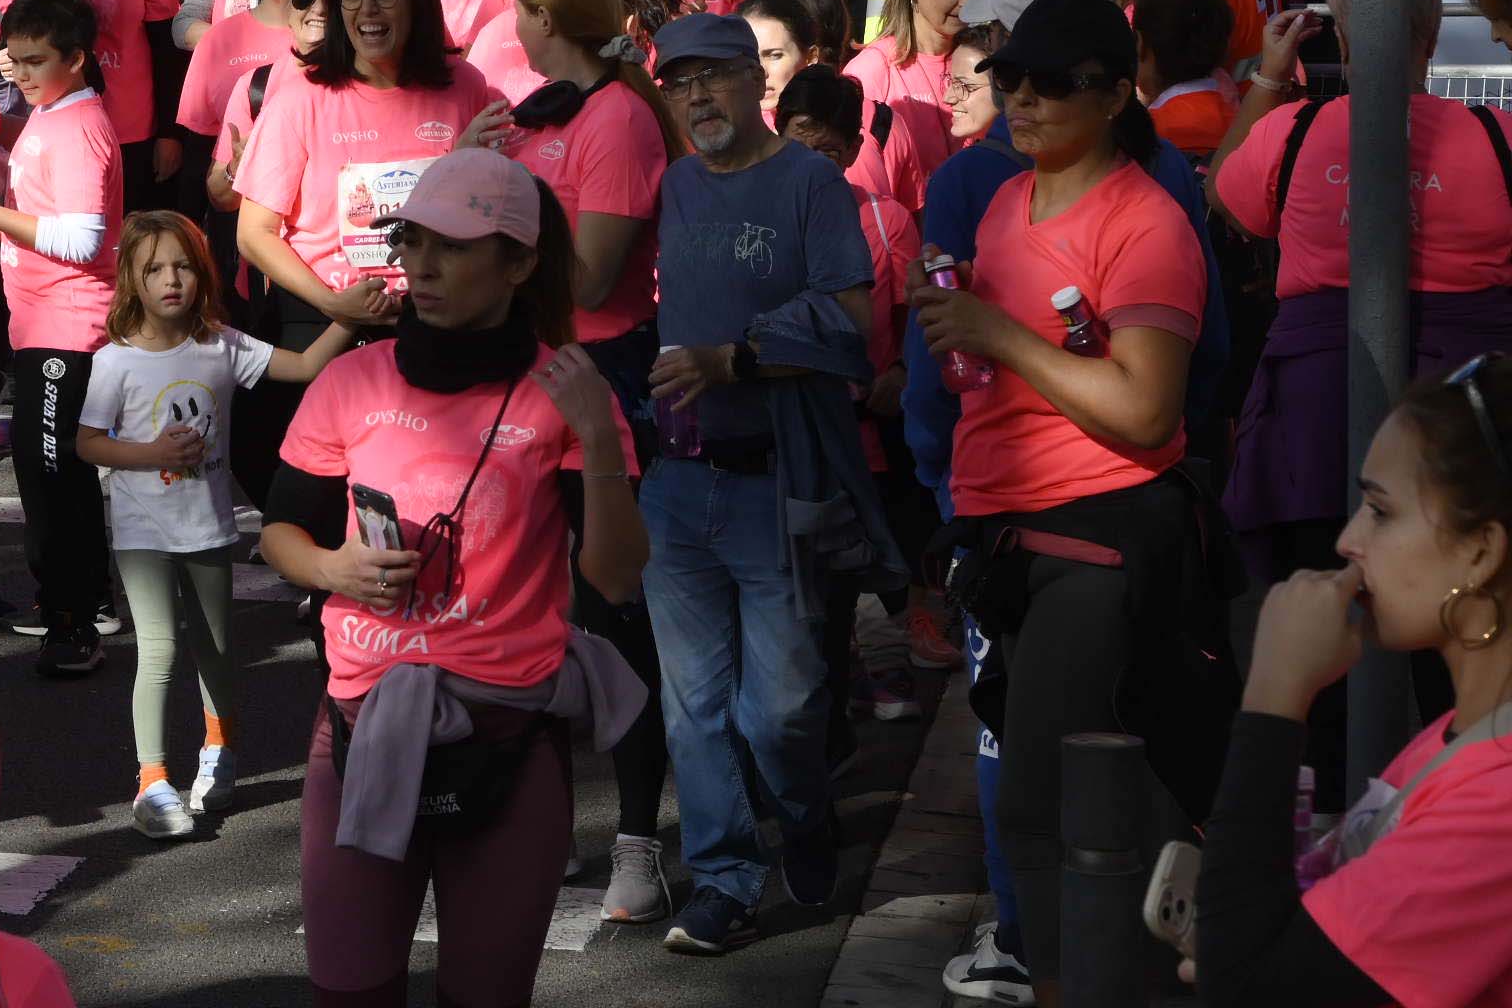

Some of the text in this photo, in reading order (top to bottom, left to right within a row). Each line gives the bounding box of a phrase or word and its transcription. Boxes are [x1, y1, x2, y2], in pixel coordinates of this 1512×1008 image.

[332, 129, 378, 144] OYSHO
[352, 250, 387, 260] OYSHO
[42, 380, 59, 439] SPORT
[365, 408, 429, 432] OYSHO
[338, 614, 430, 655] SUMA
